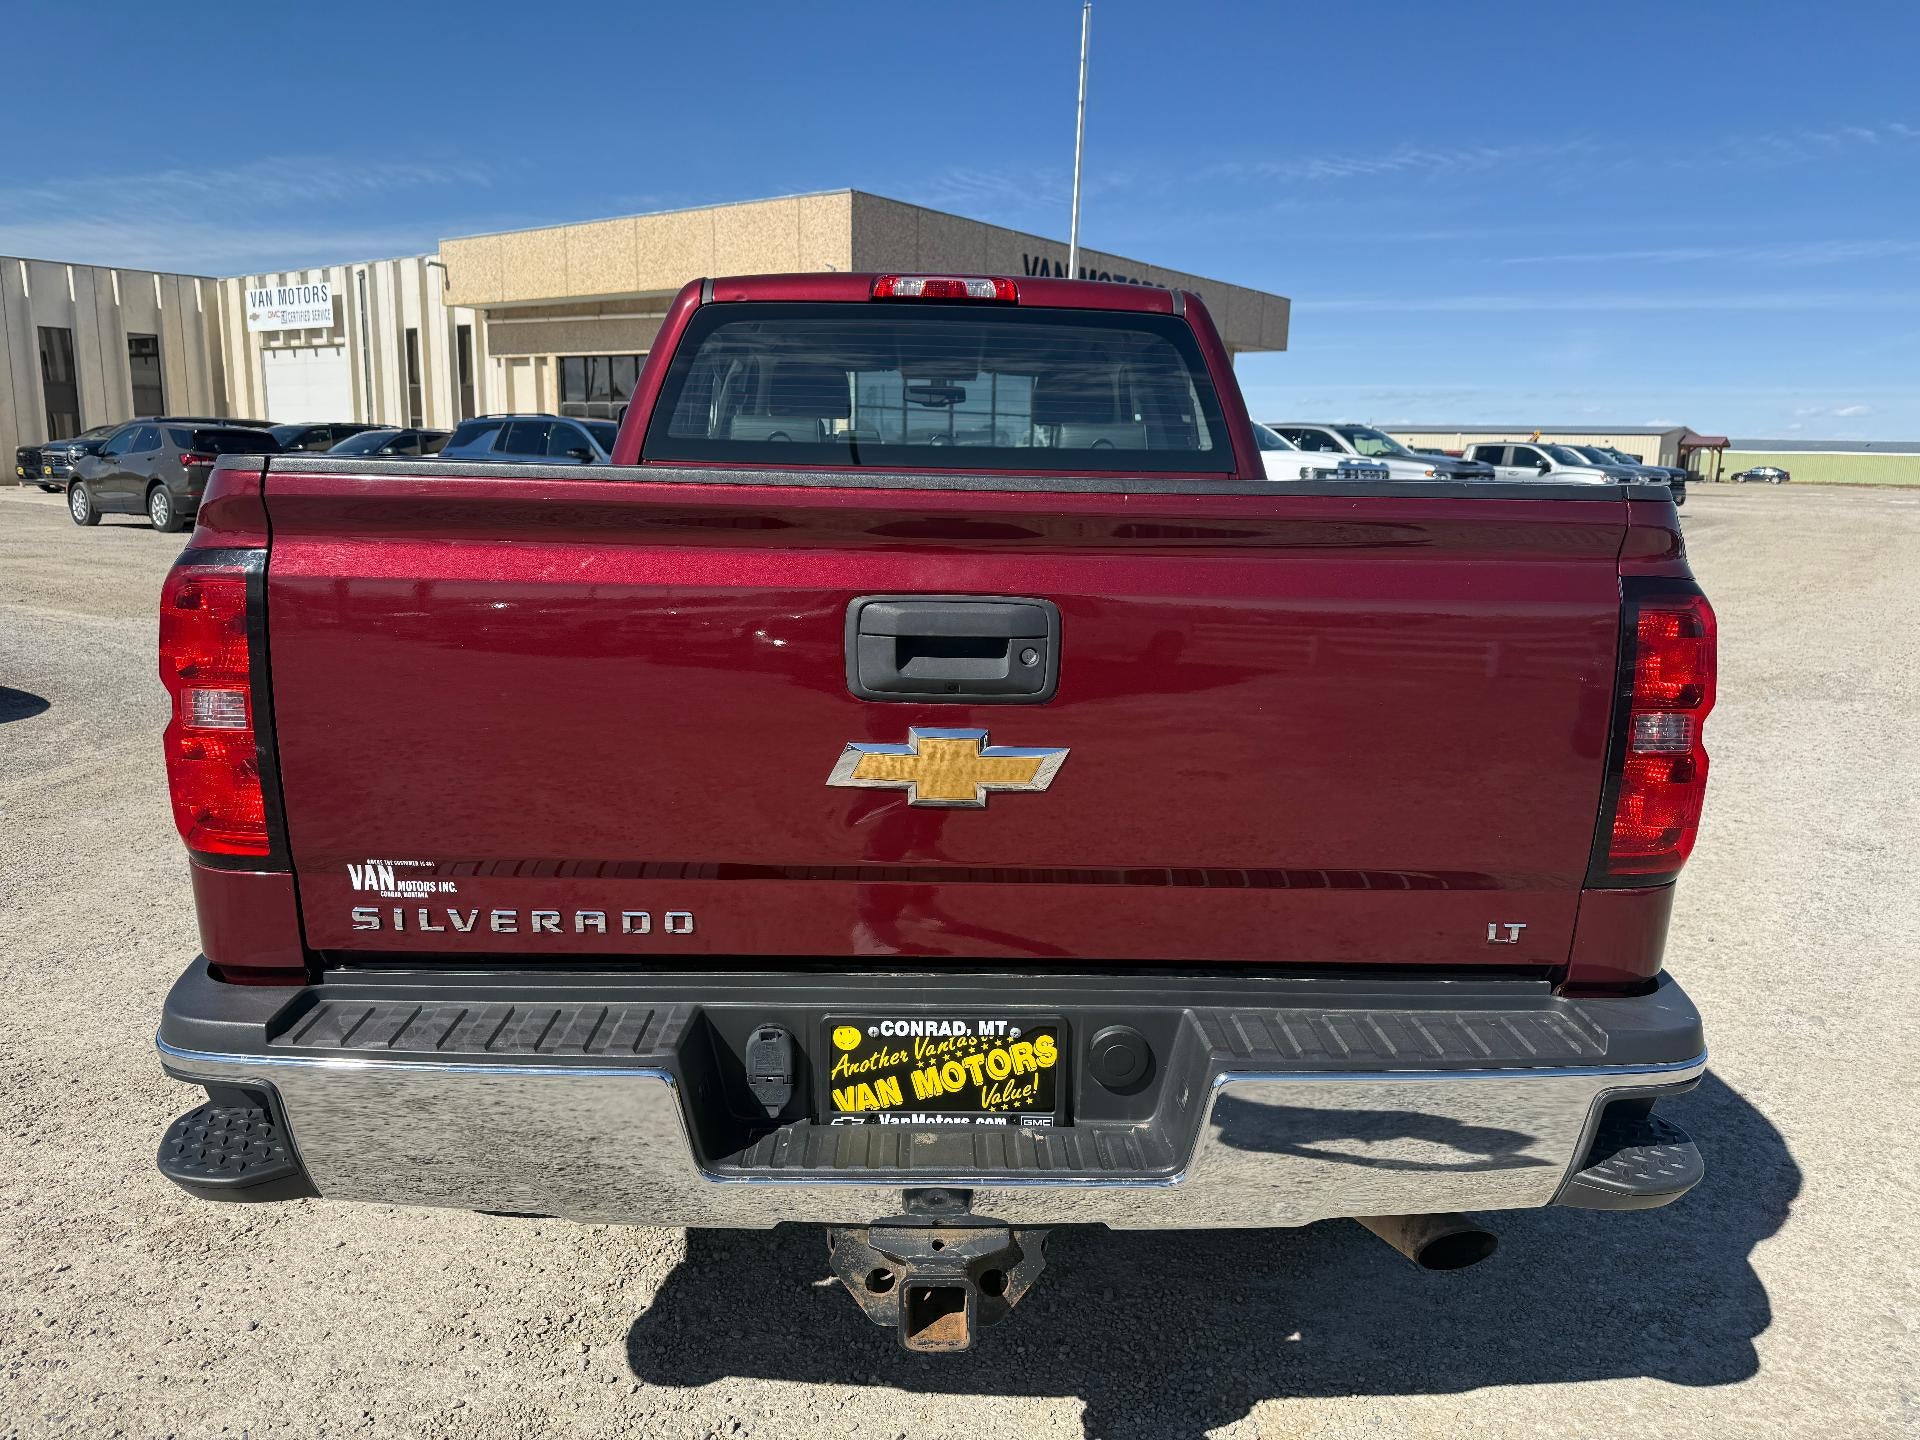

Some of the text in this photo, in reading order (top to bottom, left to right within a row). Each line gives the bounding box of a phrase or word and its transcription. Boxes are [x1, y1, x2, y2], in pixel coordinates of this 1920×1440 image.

[250, 284, 328, 308] VAN MOTORS
[288, 310, 311, 323] CERTIFIED
[312, 308, 331, 321] SERVICE
[347, 864, 458, 893] VAN MOTORS INC.
[351, 906, 696, 935] SILVERADO
[1487, 922, 1527, 944] LT
[880, 1020, 1008, 1037] CONRAD, MT
[831, 1036, 994, 1081] Another Vantas
[832, 1034, 1058, 1112] VAN MOTORS
[980, 1072, 1039, 1109] Value!
[878, 1113, 1007, 1125] VanMotorscom
